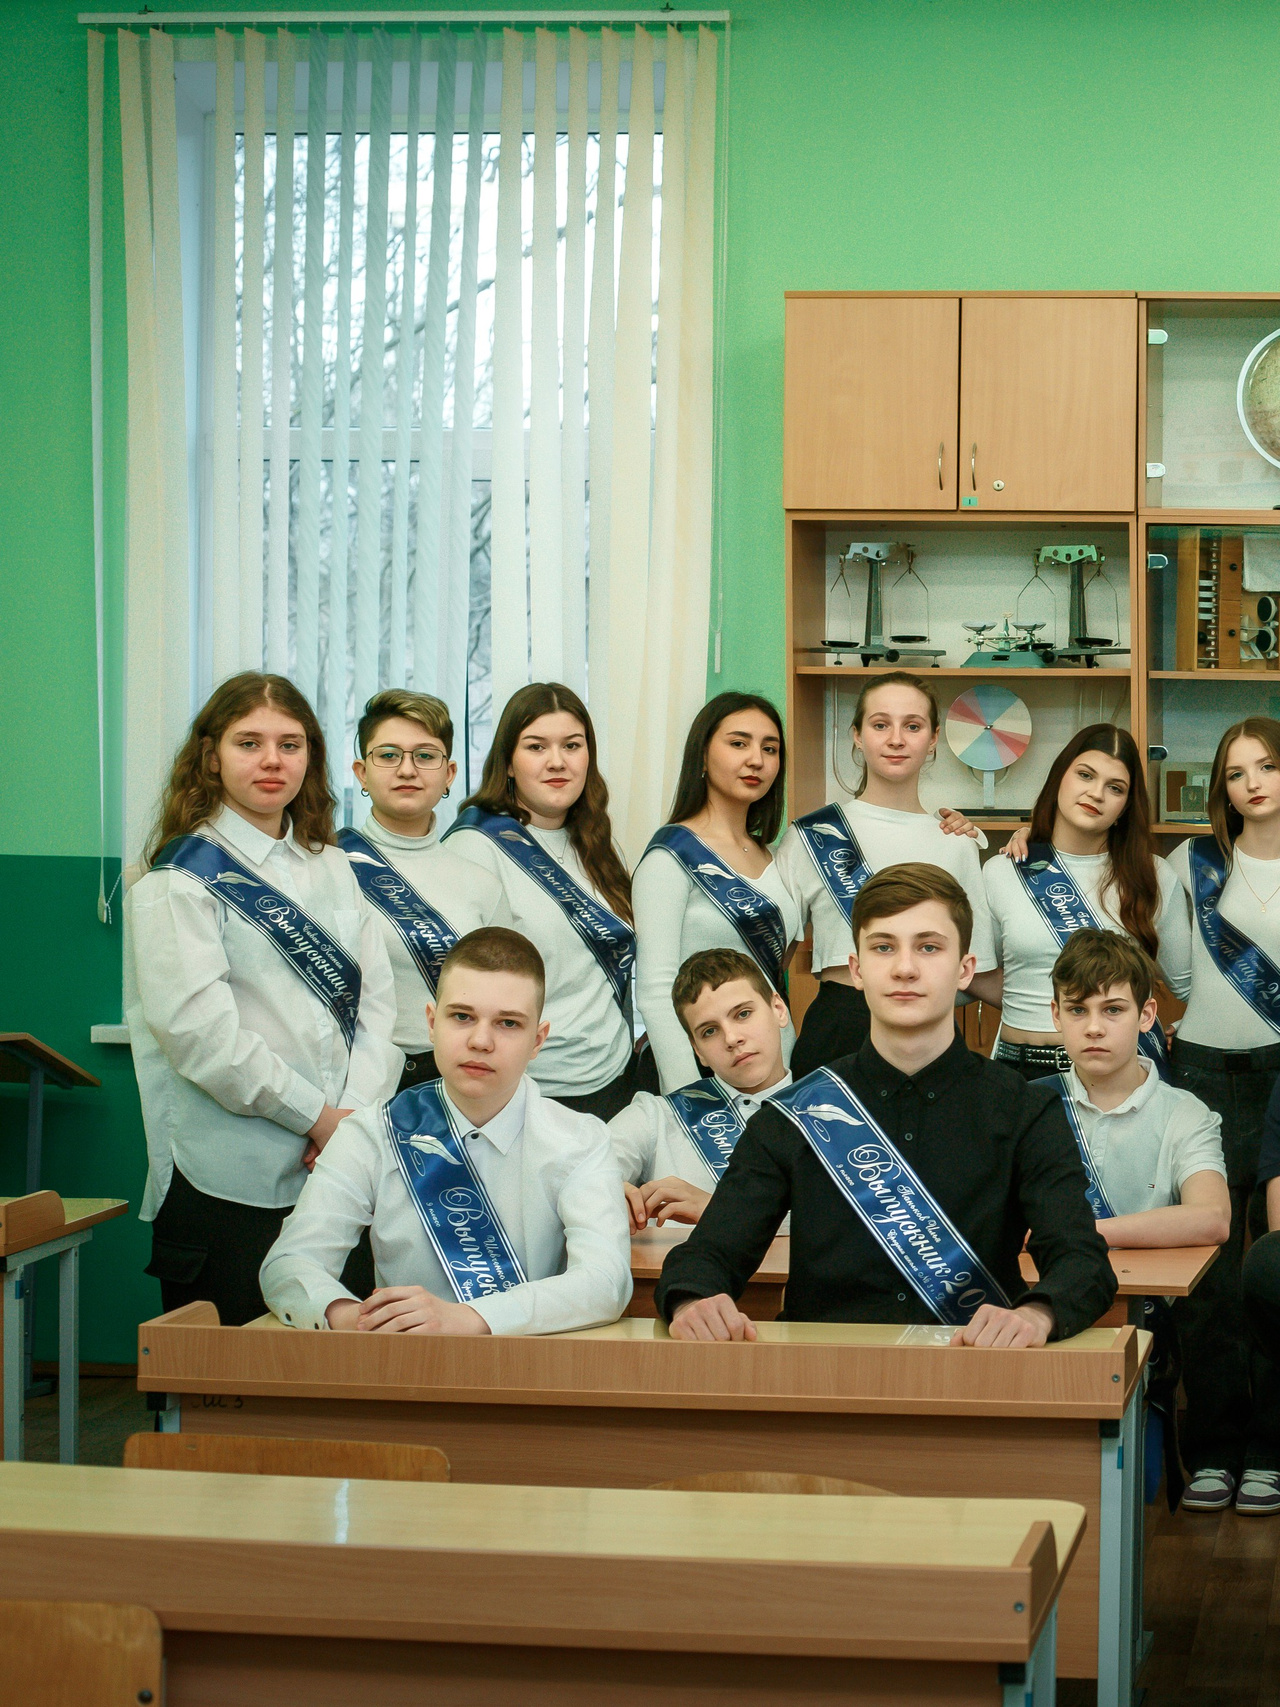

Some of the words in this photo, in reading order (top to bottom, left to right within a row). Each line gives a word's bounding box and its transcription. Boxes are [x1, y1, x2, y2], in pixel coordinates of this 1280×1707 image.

[529, 854, 618, 945] Выпускница
[1201, 896, 1267, 989] Выпускница
[255, 895, 354, 1004] Выпускница
[847, 1143, 952, 1278] Выпускник
[896, 1184, 931, 1222] Паньков
[927, 1218, 942, 1244] Илья
[483, 1234, 506, 1281] Шевченко
